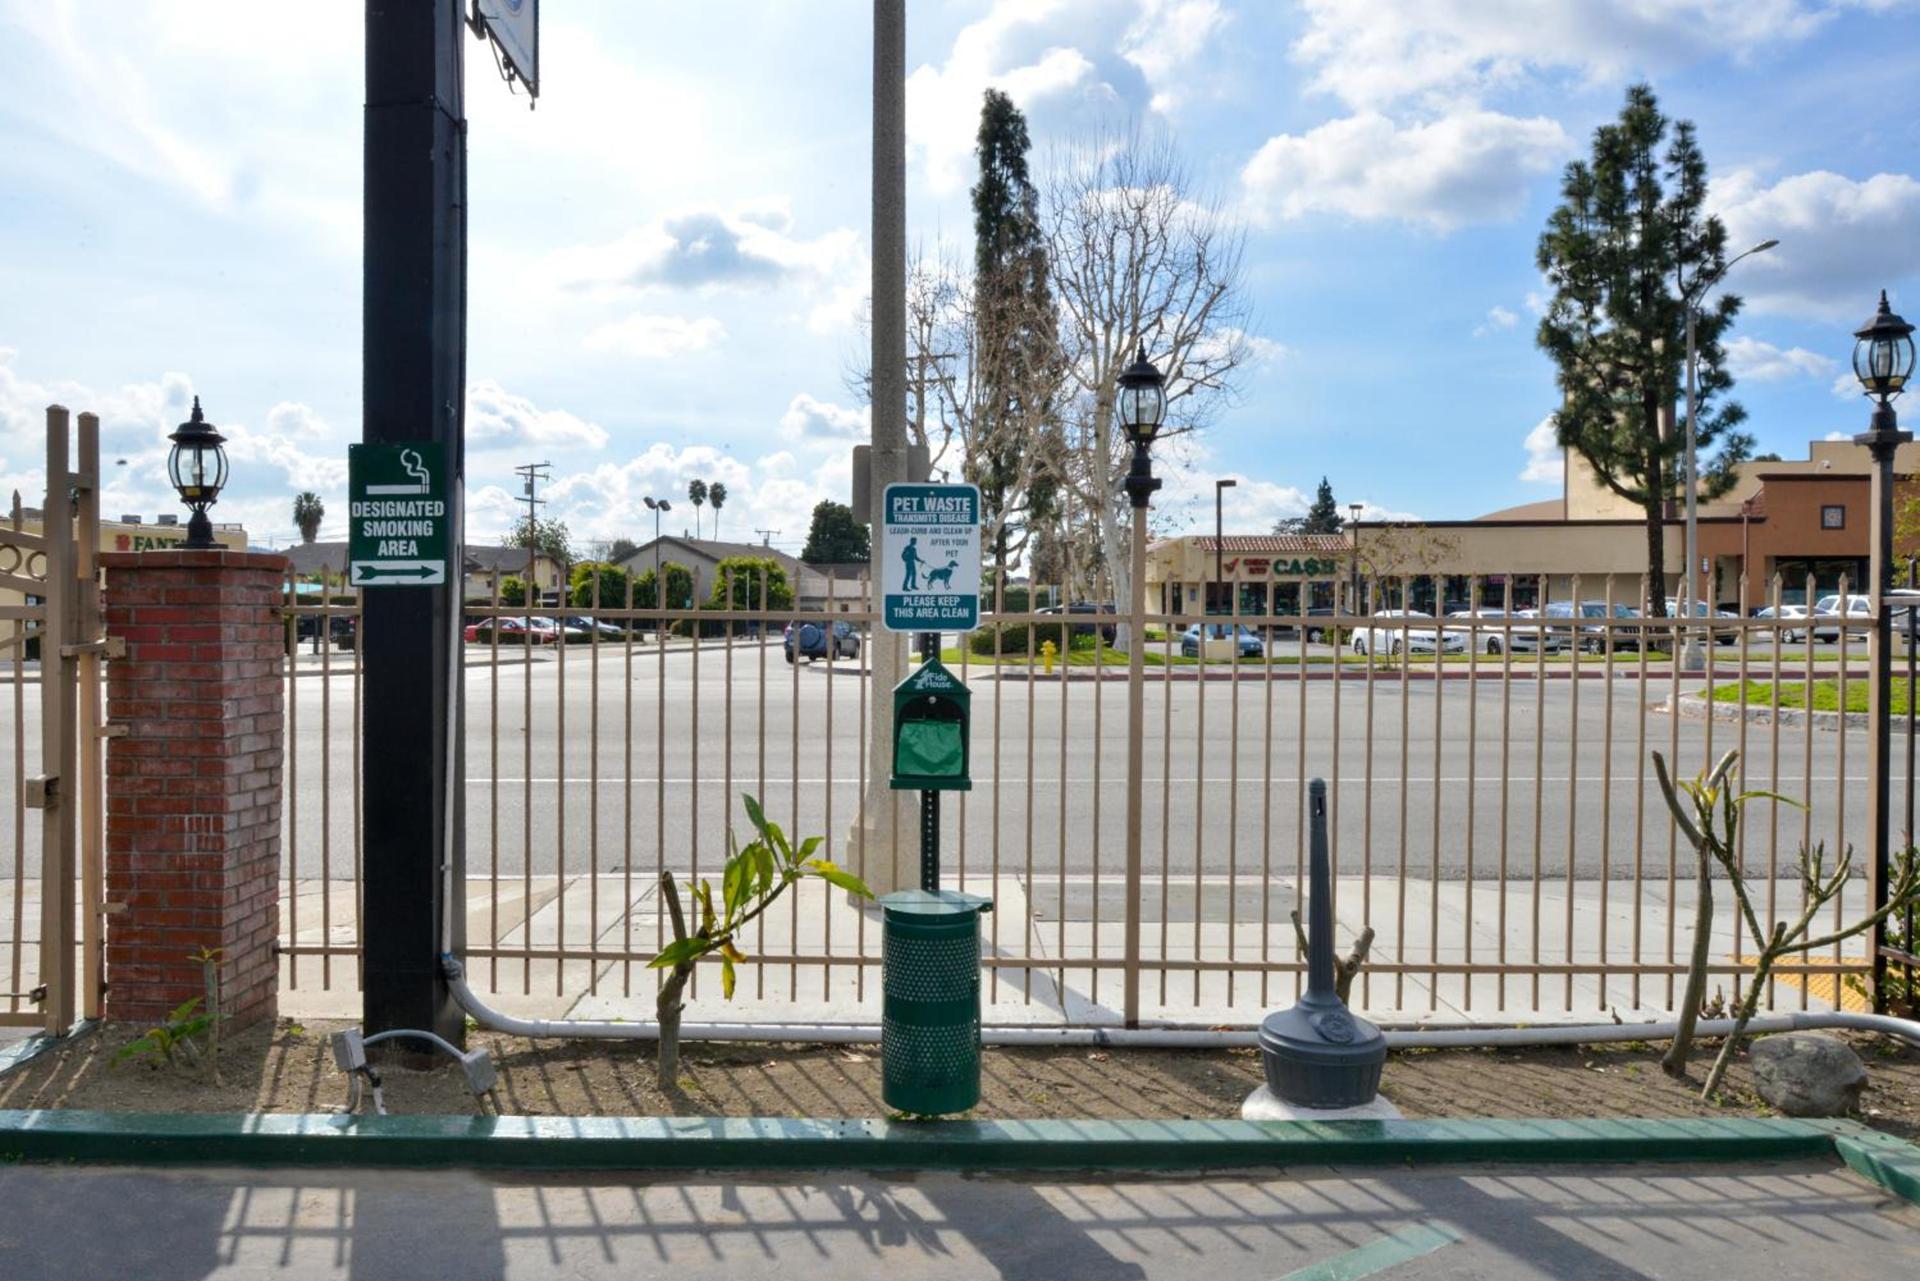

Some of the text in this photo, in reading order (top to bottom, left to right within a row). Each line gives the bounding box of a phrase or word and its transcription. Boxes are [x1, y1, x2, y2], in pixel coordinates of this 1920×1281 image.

[352, 501, 444, 517] DESIGNATED
[893, 497, 971, 511] PET WASTE
[894, 514, 971, 523] TRANSMITS DISEASE
[363, 520, 433, 537] SMOKING
[377, 540, 418, 556] AREA
[903, 596, 960, 606] PLEASE KEEP
[893, 607, 970, 618] THIS AREA CLEAN
[928, 672, 948, 681] Fido
